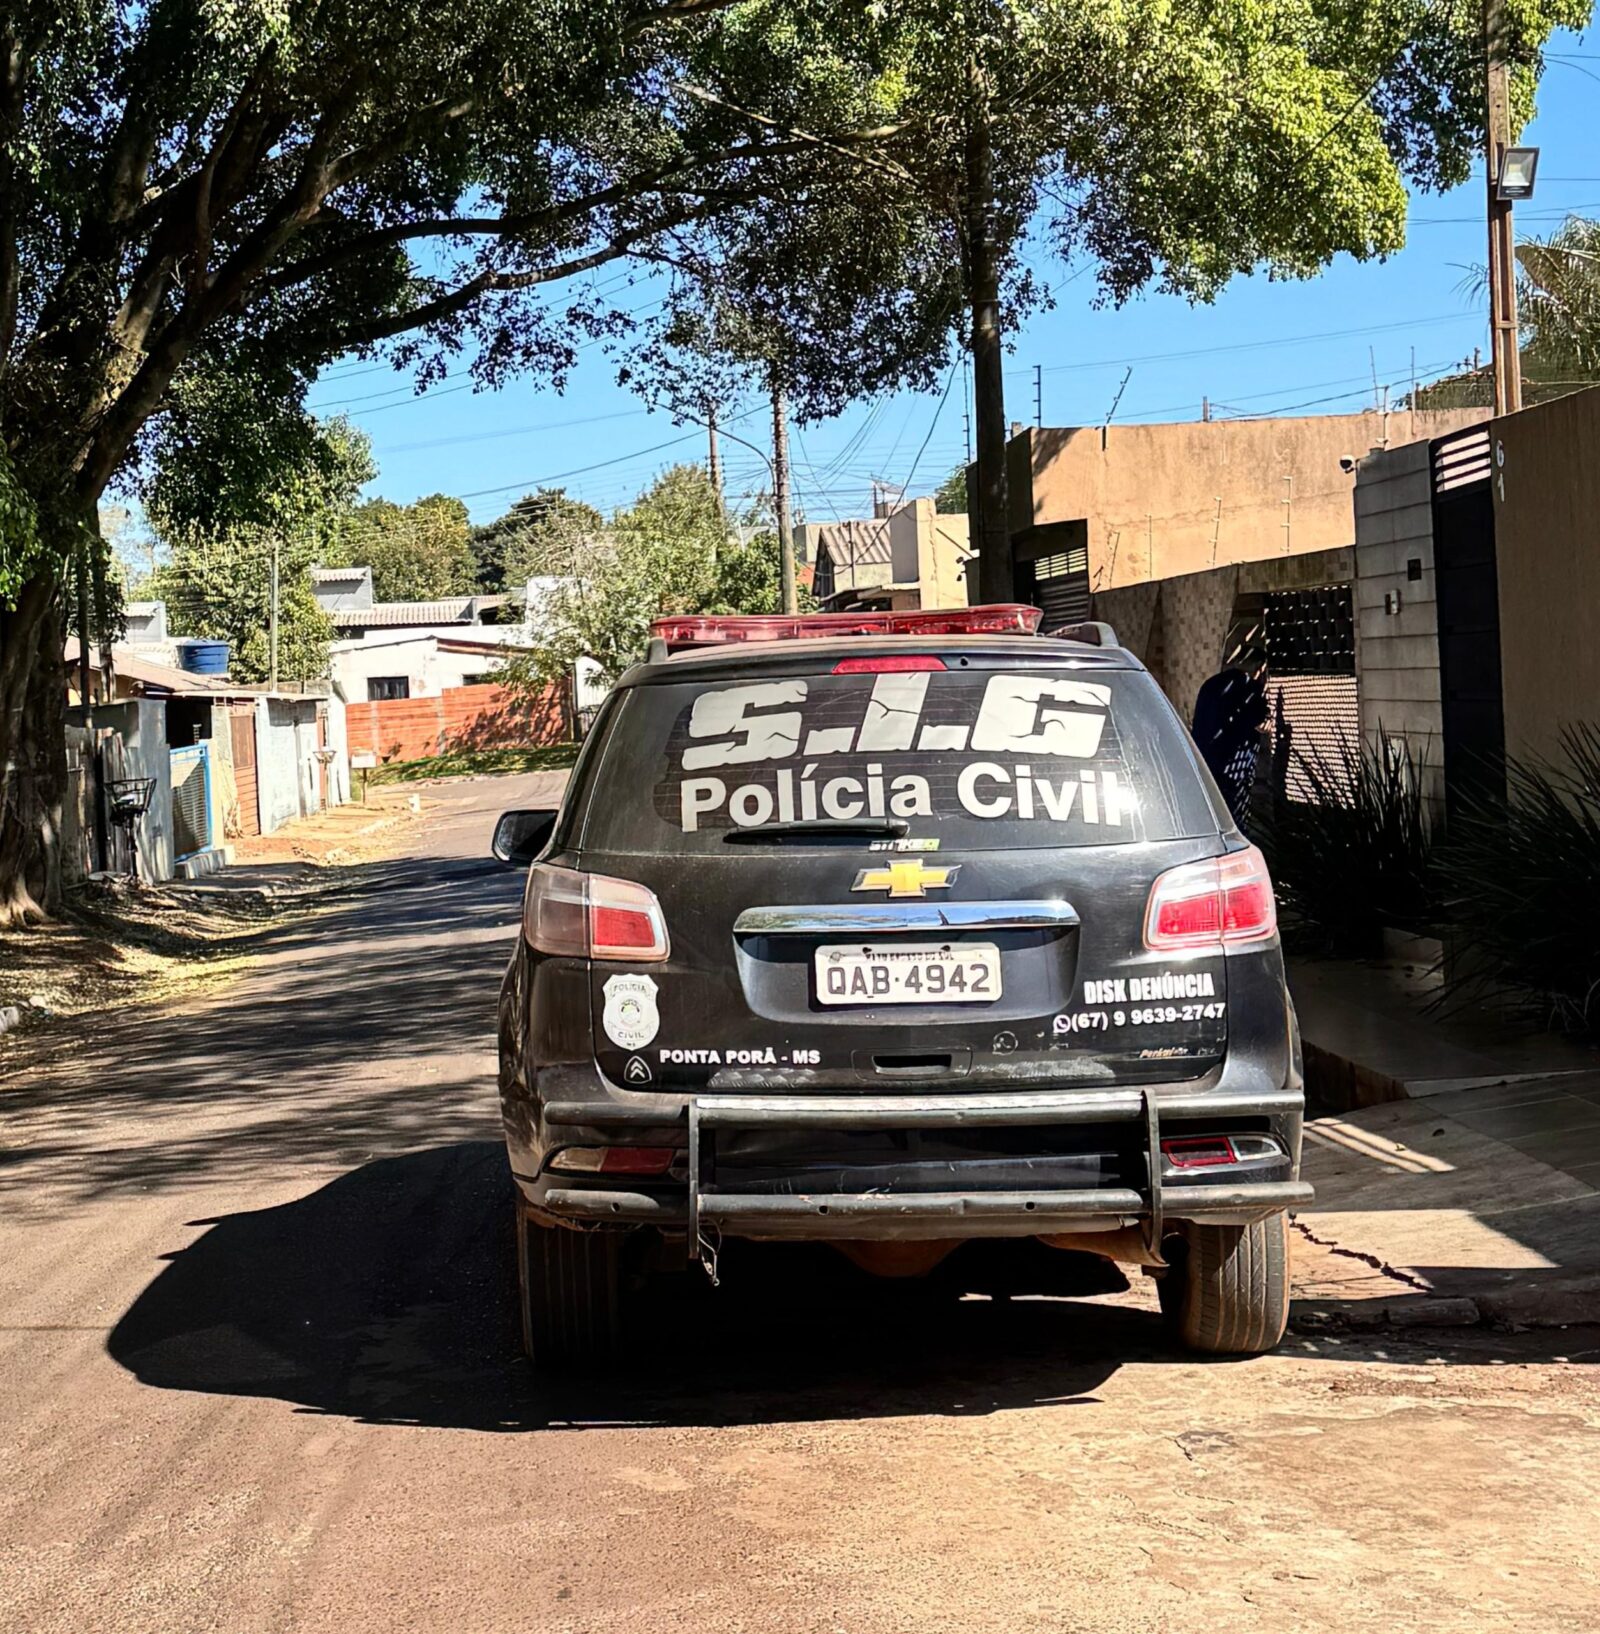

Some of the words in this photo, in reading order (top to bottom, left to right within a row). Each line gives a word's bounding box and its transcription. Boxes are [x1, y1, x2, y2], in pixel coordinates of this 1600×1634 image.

[681, 762, 933, 833] Polícia
[956, 762, 1122, 827] Civil
[1083, 979, 1128, 1004] DISK
[1129, 971, 1215, 1001] DENÚNCIA
[1071, 1011, 1108, 1032] (67)
[1113, 1010, 1126, 1026] 9
[1131, 1003, 1226, 1026] 9639-2747
[660, 1050, 721, 1064] PONTA
[726, 1047, 777, 1064] PORÃ
[793, 1050, 821, 1064] MS
